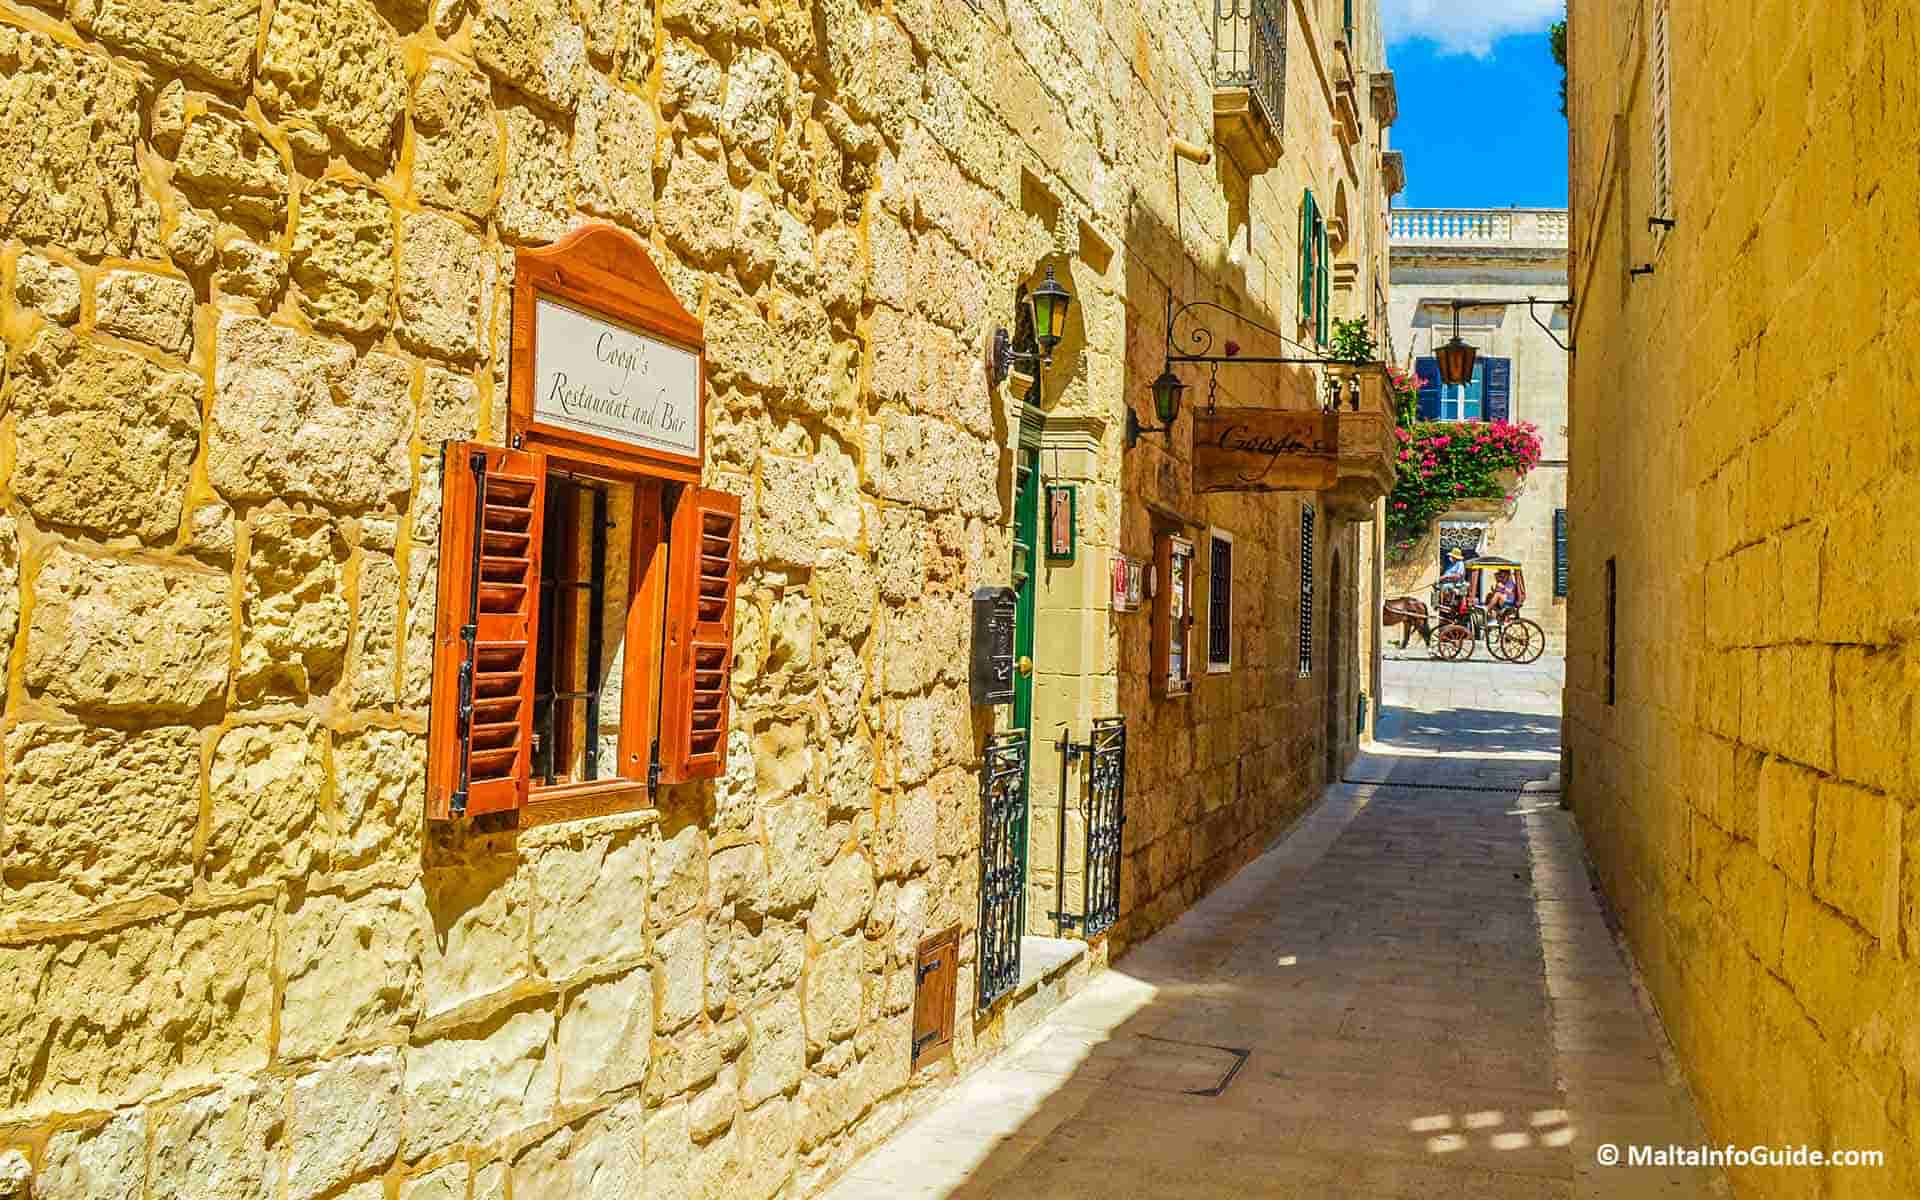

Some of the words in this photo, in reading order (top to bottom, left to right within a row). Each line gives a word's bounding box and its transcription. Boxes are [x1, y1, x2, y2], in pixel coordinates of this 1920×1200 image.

[549, 372, 632, 419] Restaurant
[632, 389, 666, 431] and
[661, 400, 688, 433] Bar
